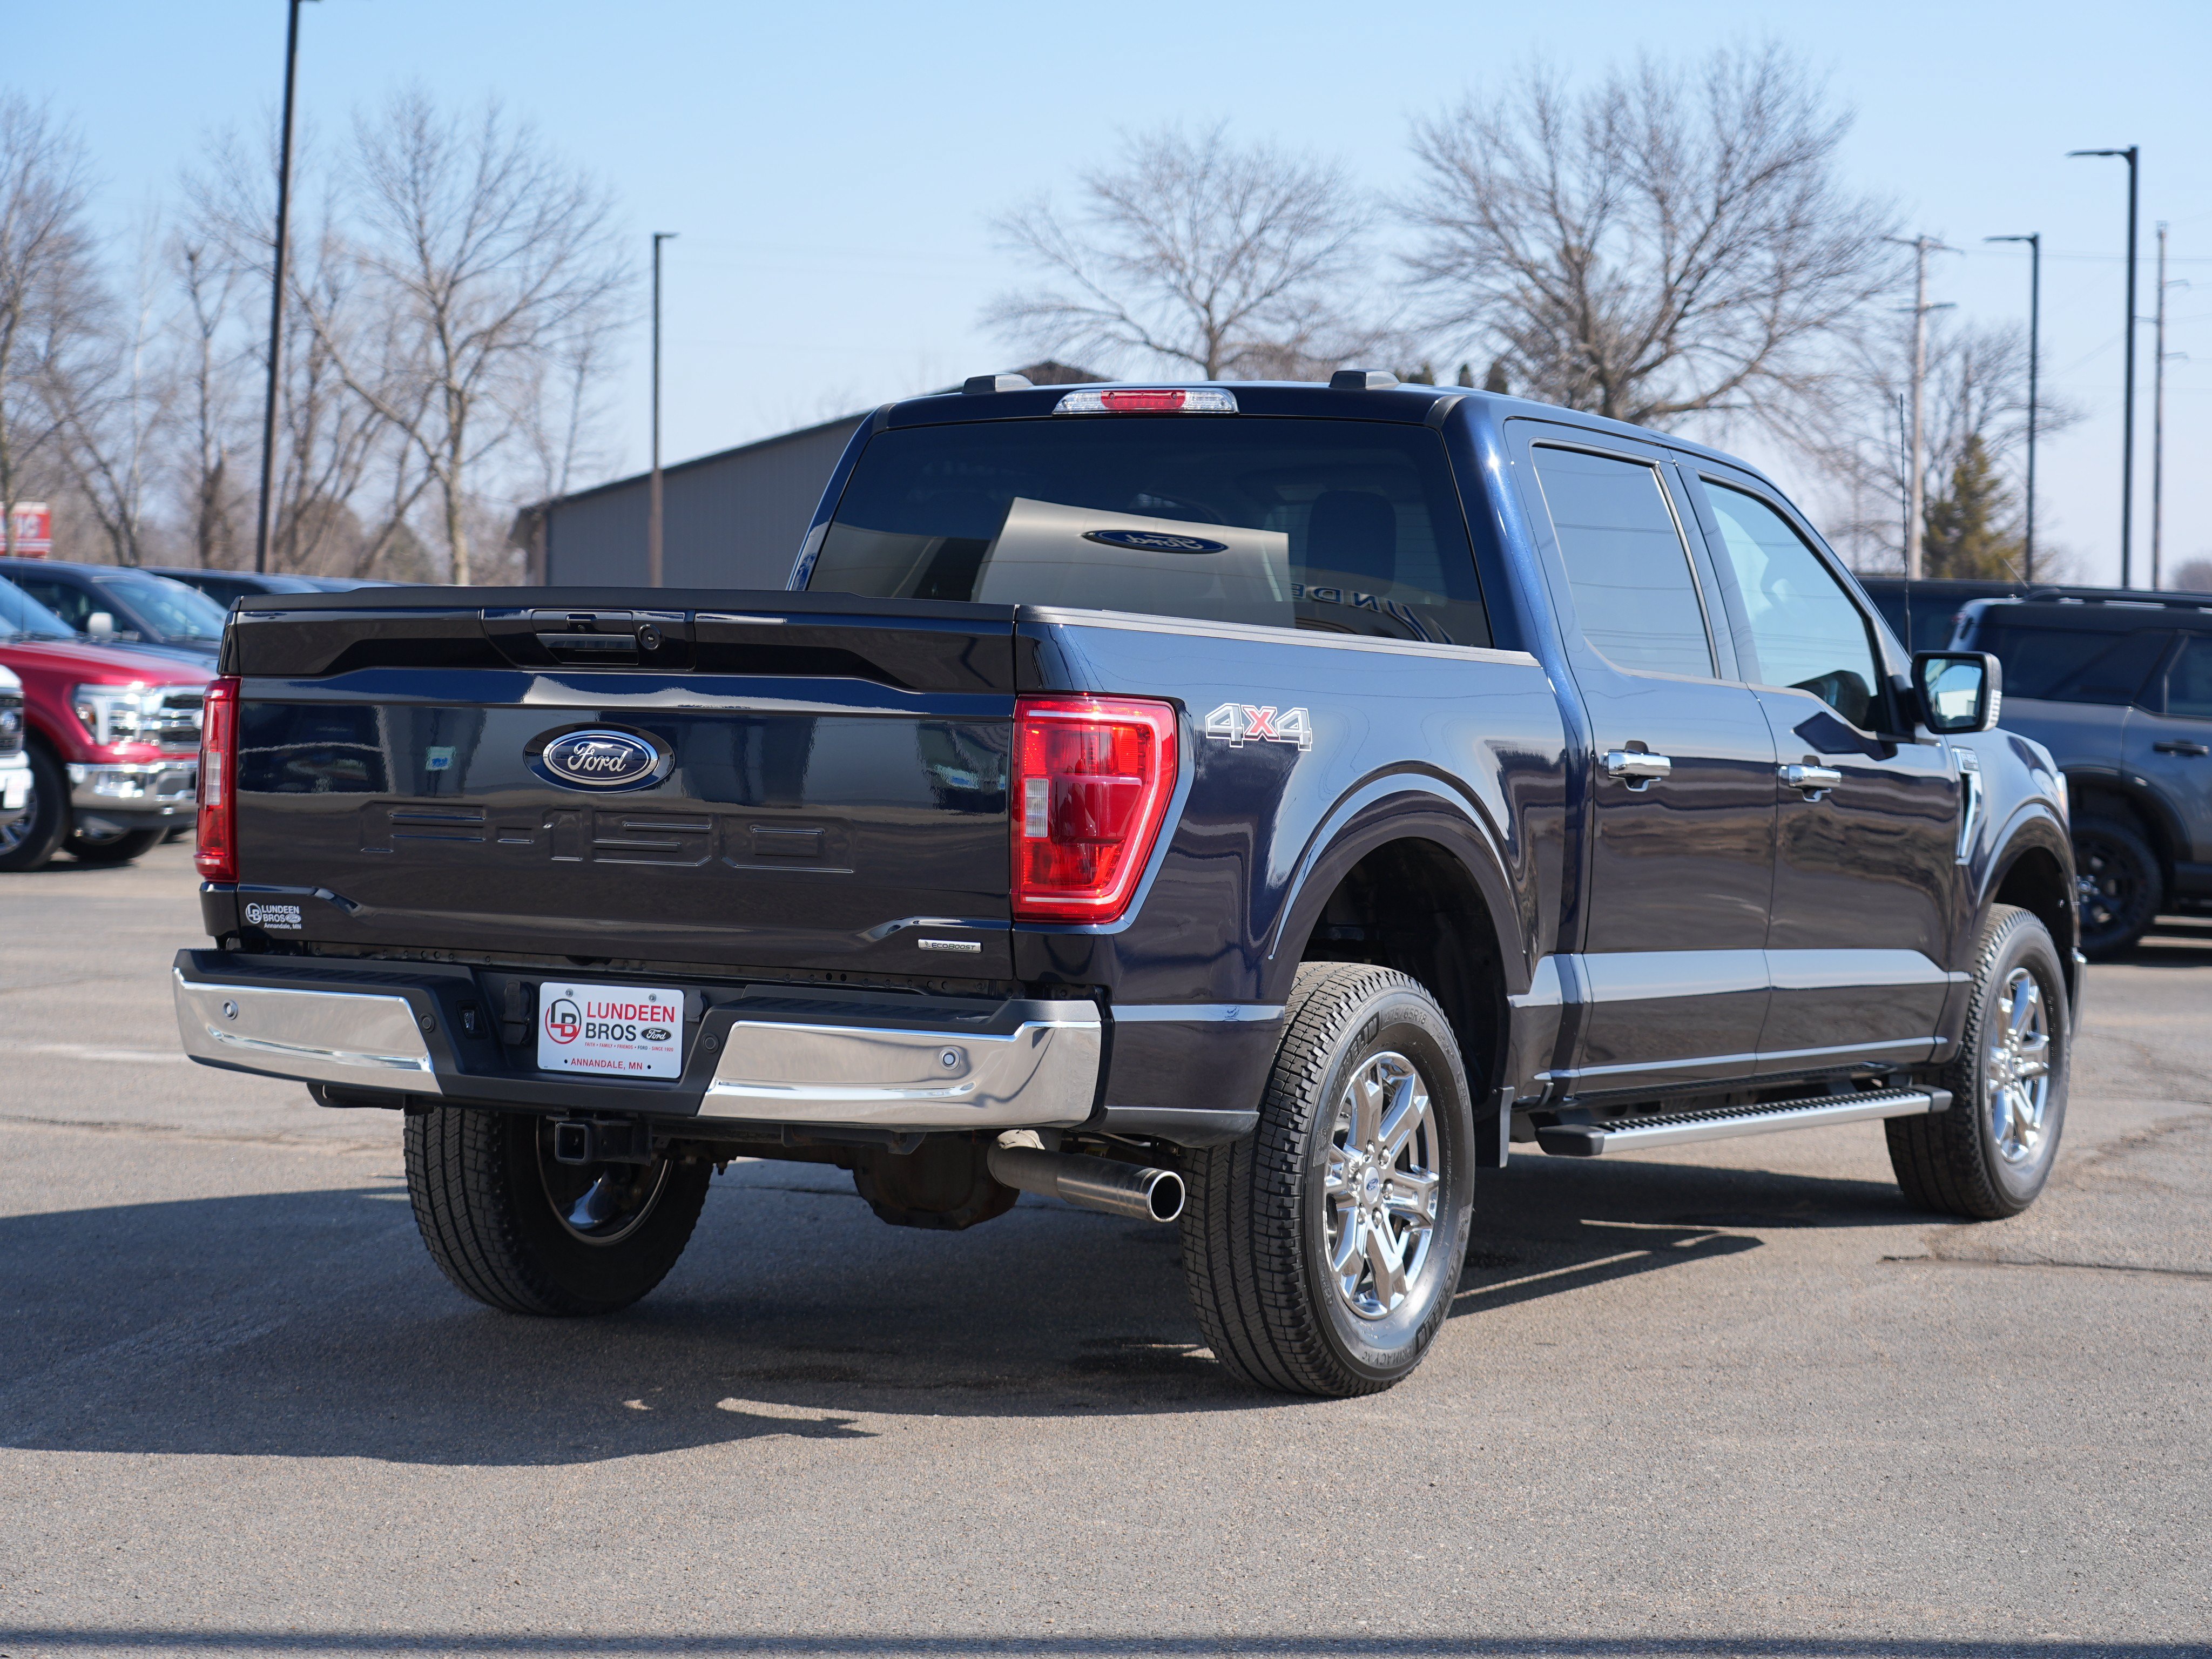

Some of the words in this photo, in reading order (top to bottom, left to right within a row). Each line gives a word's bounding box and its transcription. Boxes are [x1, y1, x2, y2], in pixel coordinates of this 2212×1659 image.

[567, 740, 629, 772] Ford
[261, 905, 300, 914] LUNDEEN
[263, 914, 286, 922] BROS
[587, 1001, 675, 1023] LUNDEEN
[1384, 1007, 1427, 1024] 275/65R18
[585, 1022, 637, 1041] BROS
[646, 1028, 666, 1040] Ford
[571, 1057, 625, 1070] ANNANDALE,
[629, 1062, 643, 1070] MN
[1372, 1345, 1414, 1366] PRIMACY
